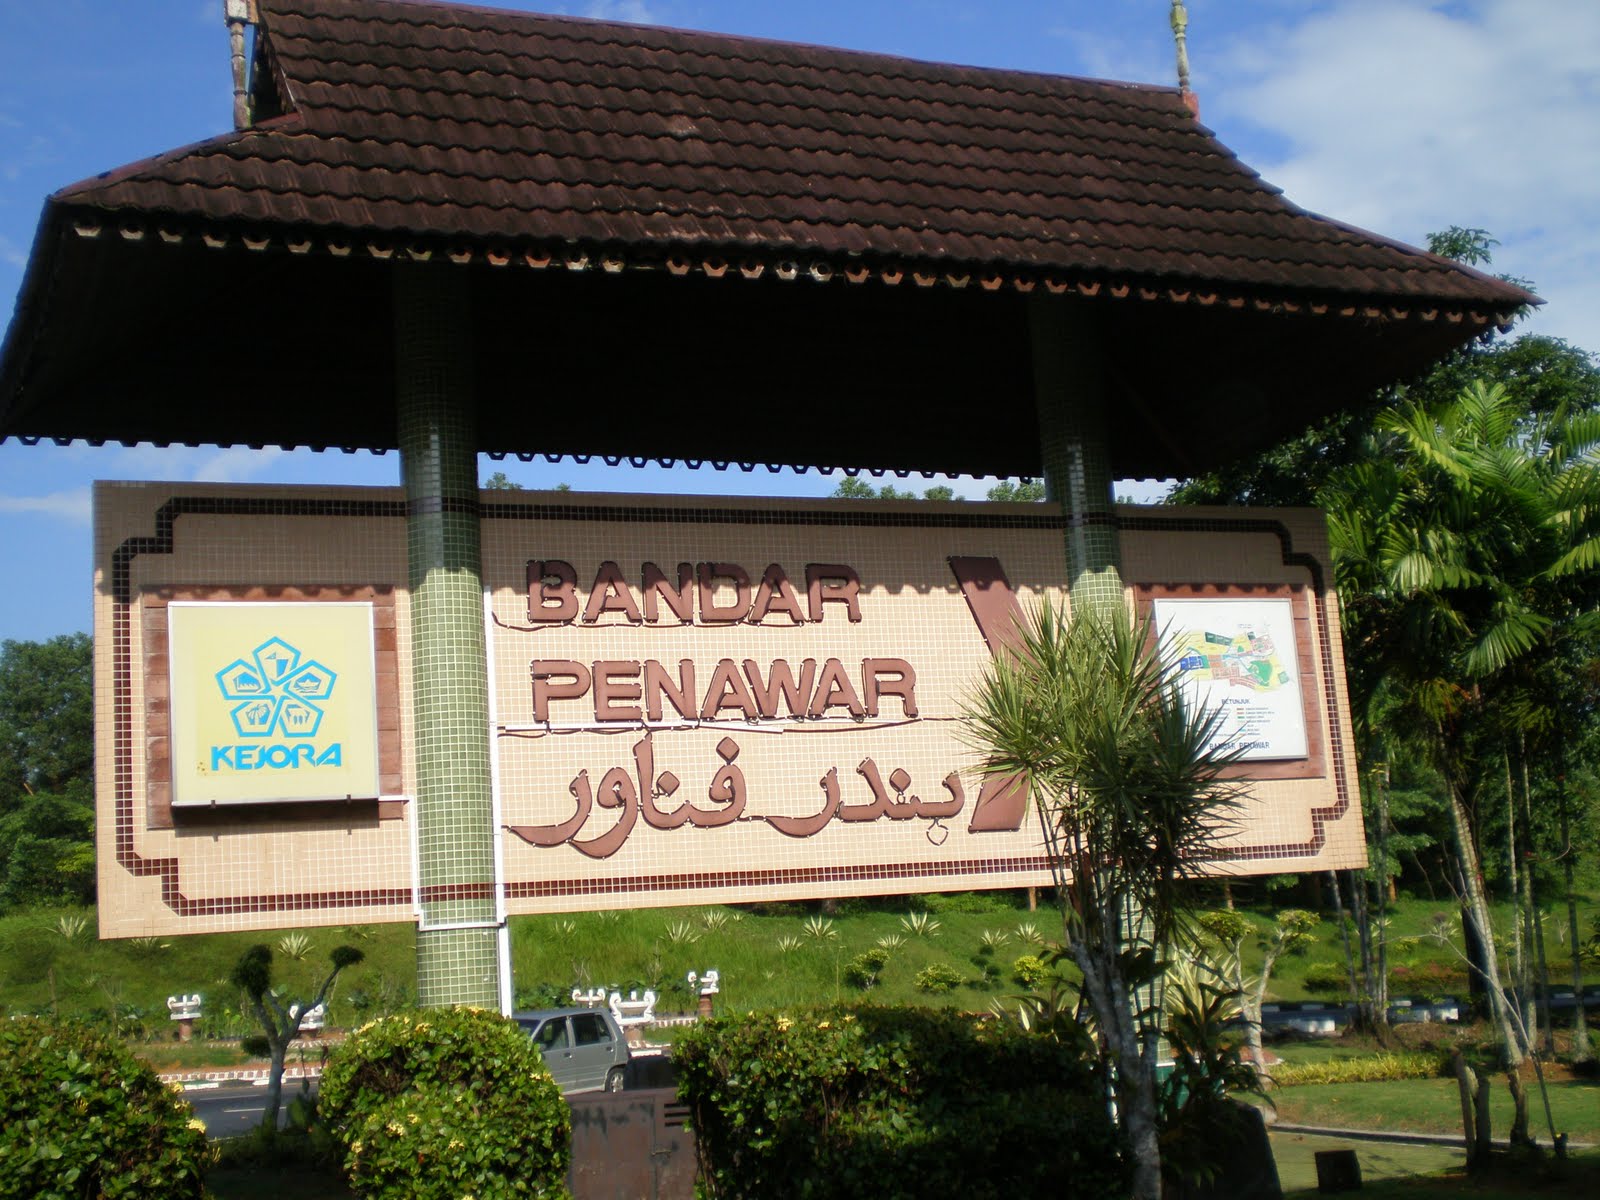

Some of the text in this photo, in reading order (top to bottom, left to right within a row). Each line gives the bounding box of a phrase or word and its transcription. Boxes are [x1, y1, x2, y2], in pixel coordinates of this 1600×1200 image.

[526, 560, 863, 624] BANDAR
[530, 657, 919, 724] PENAWAR
[210, 742, 342, 772] KEJORA
